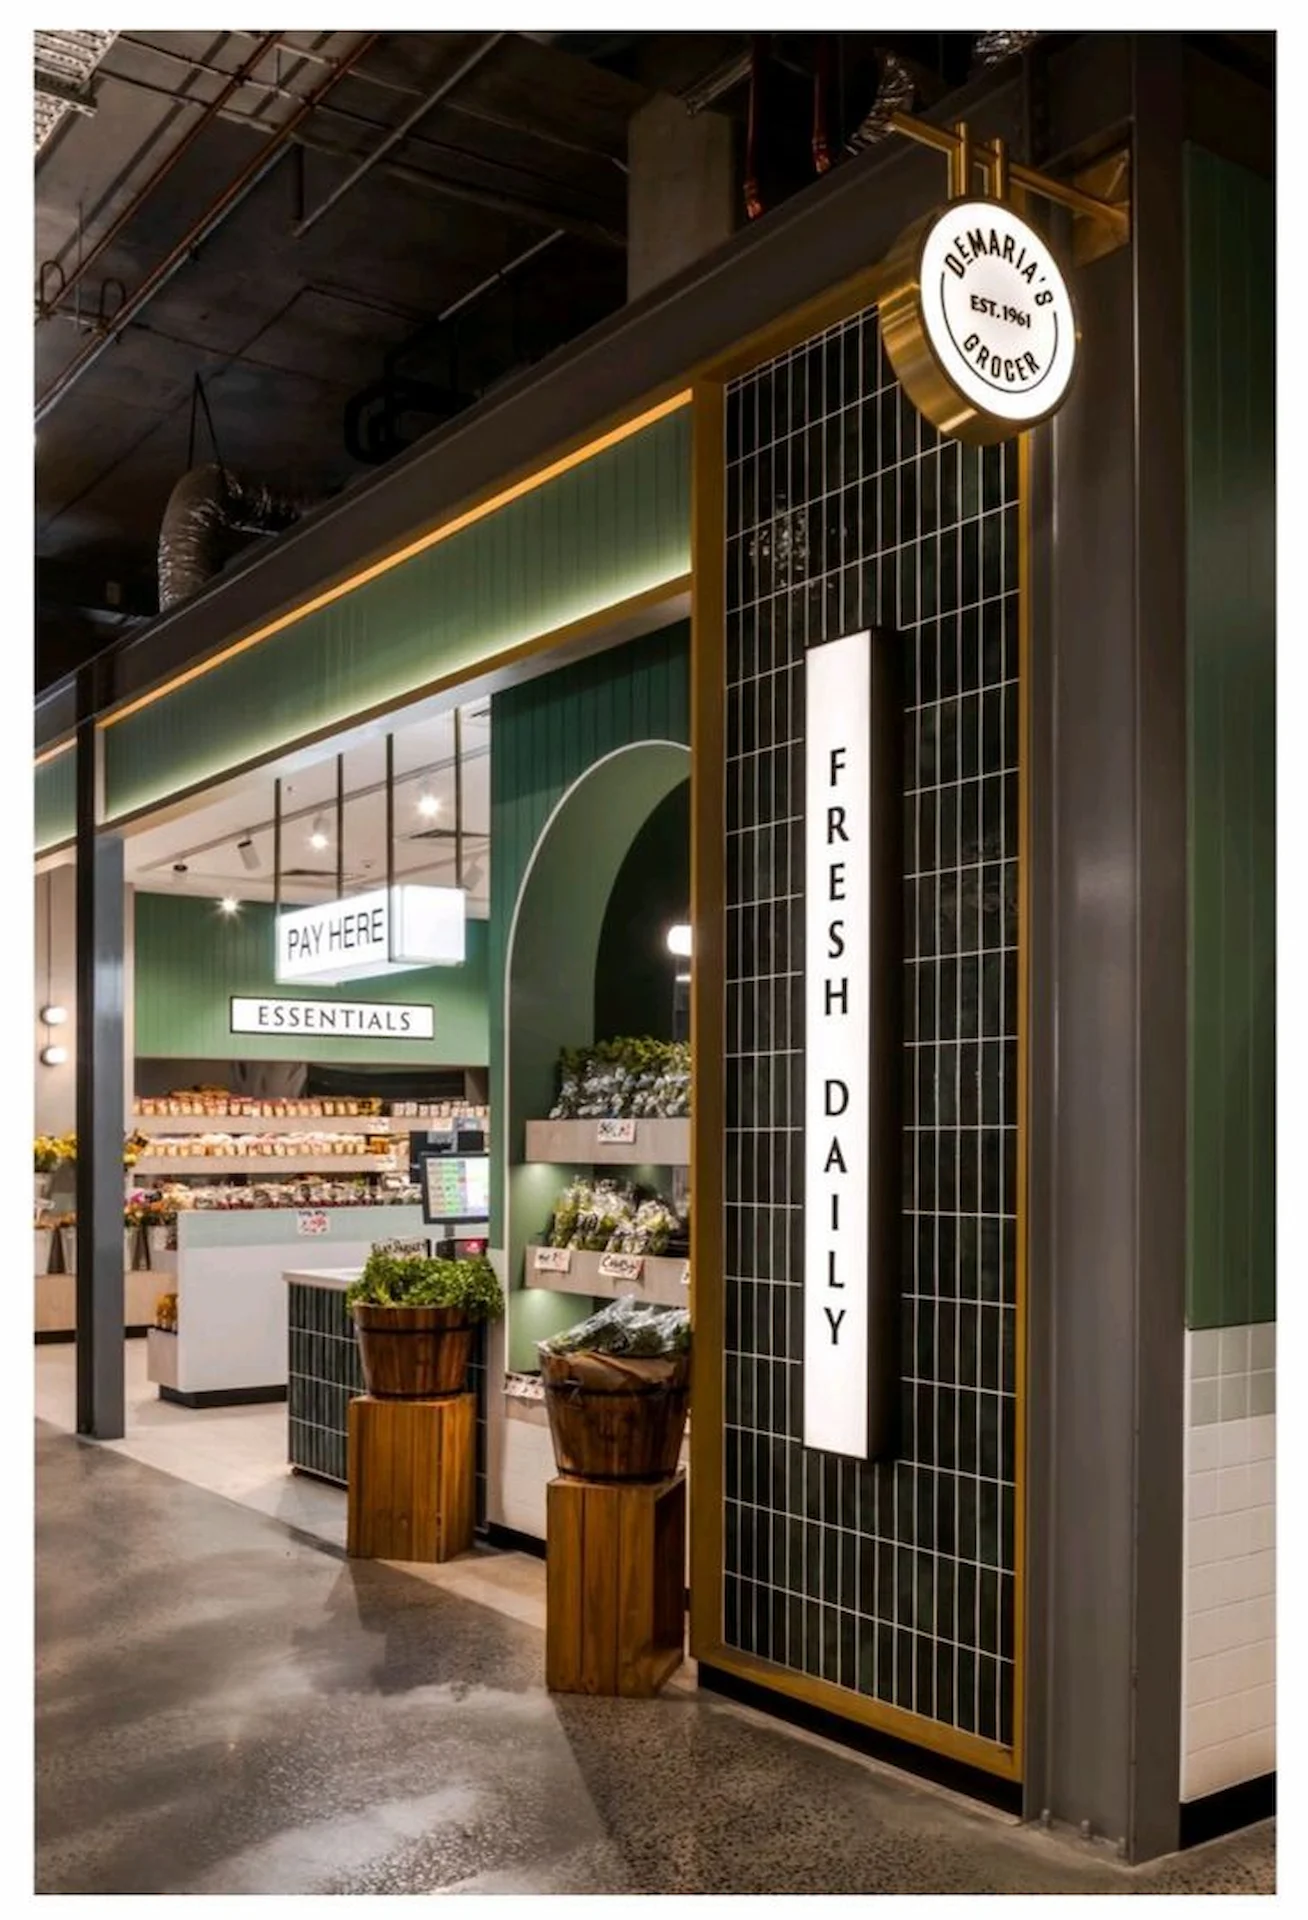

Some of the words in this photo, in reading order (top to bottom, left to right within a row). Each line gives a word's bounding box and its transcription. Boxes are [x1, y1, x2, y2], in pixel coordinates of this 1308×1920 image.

[963, 333, 1040, 382] GROCER
[824, 747, 849, 1017] FRESH
[287, 921, 324, 962] PAY
[328, 908, 384, 951] HERE
[258, 1005, 412, 1032] ESSENTIALS
[823, 1078, 850, 1346] DAILY
